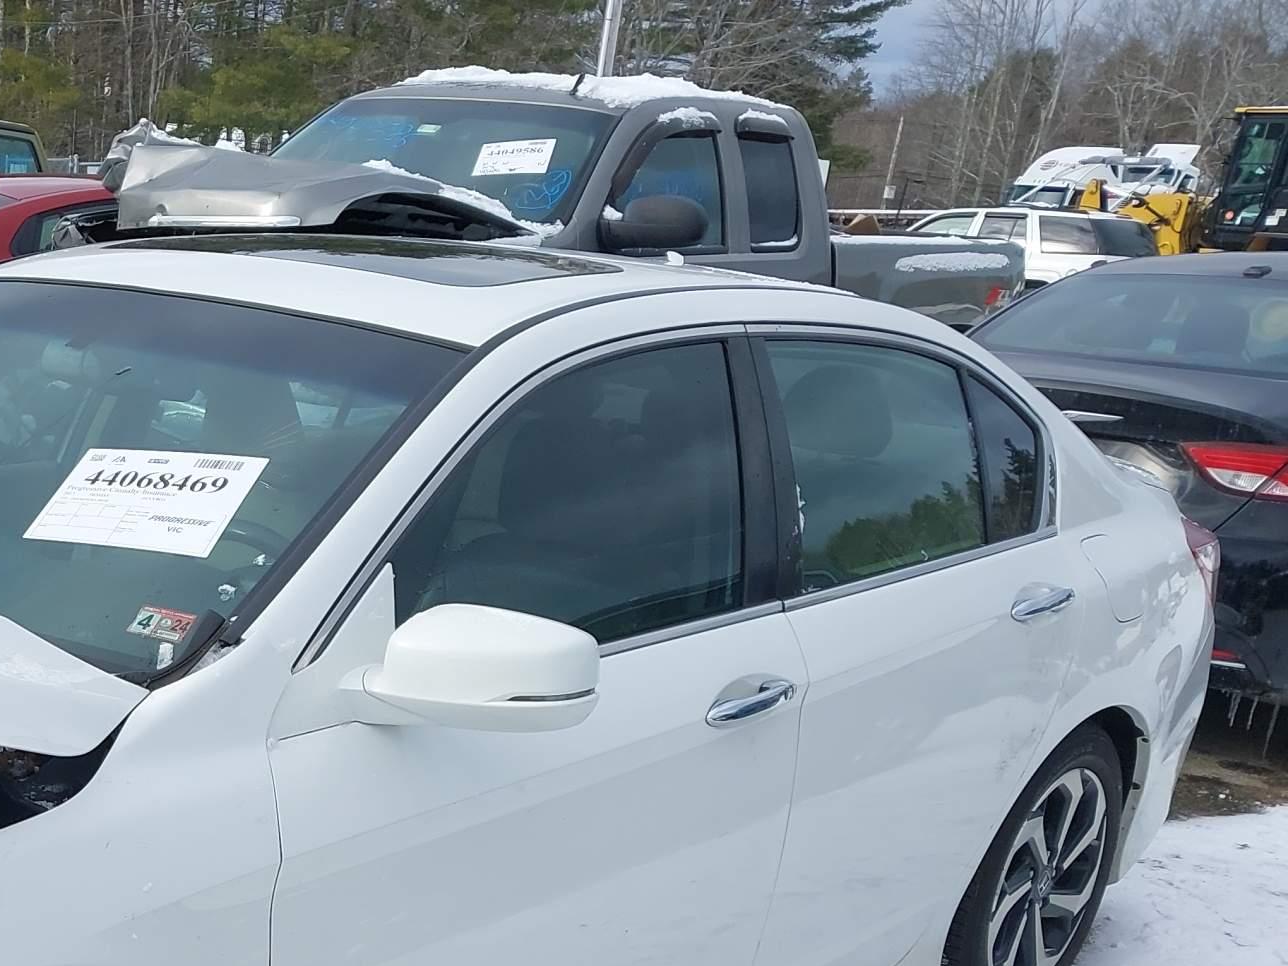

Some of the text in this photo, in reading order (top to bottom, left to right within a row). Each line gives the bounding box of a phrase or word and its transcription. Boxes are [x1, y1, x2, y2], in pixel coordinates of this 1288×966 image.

[84, 469, 229, 494] 44068469
[167, 526, 184, 534] VIC
[137, 614, 155, 630] 4
